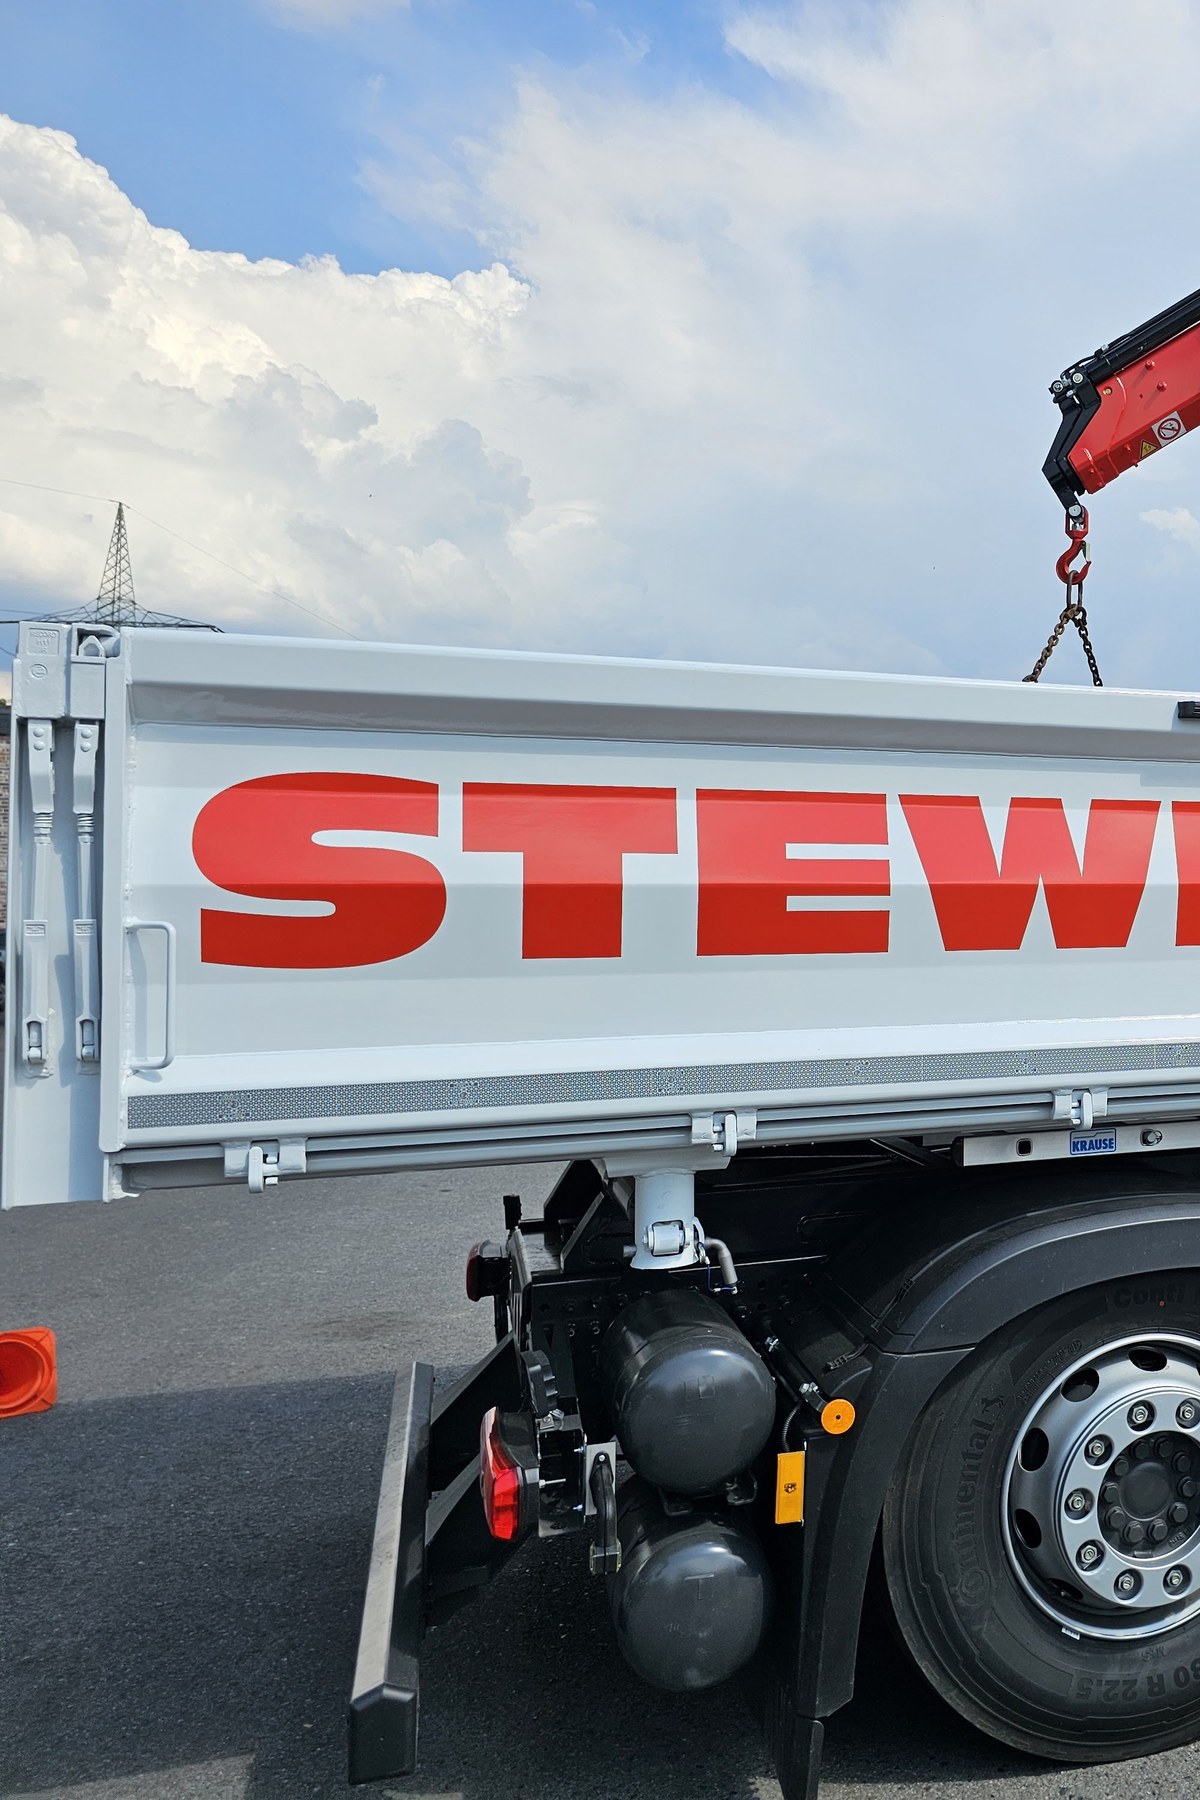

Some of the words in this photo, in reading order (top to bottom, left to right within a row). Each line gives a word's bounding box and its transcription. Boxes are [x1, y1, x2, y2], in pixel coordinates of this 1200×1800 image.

[1071, 1137, 1115, 1153] KRAUSE
[1075, 1677, 1139, 1702] 22.5
[1146, 1673, 1166, 1699] R
